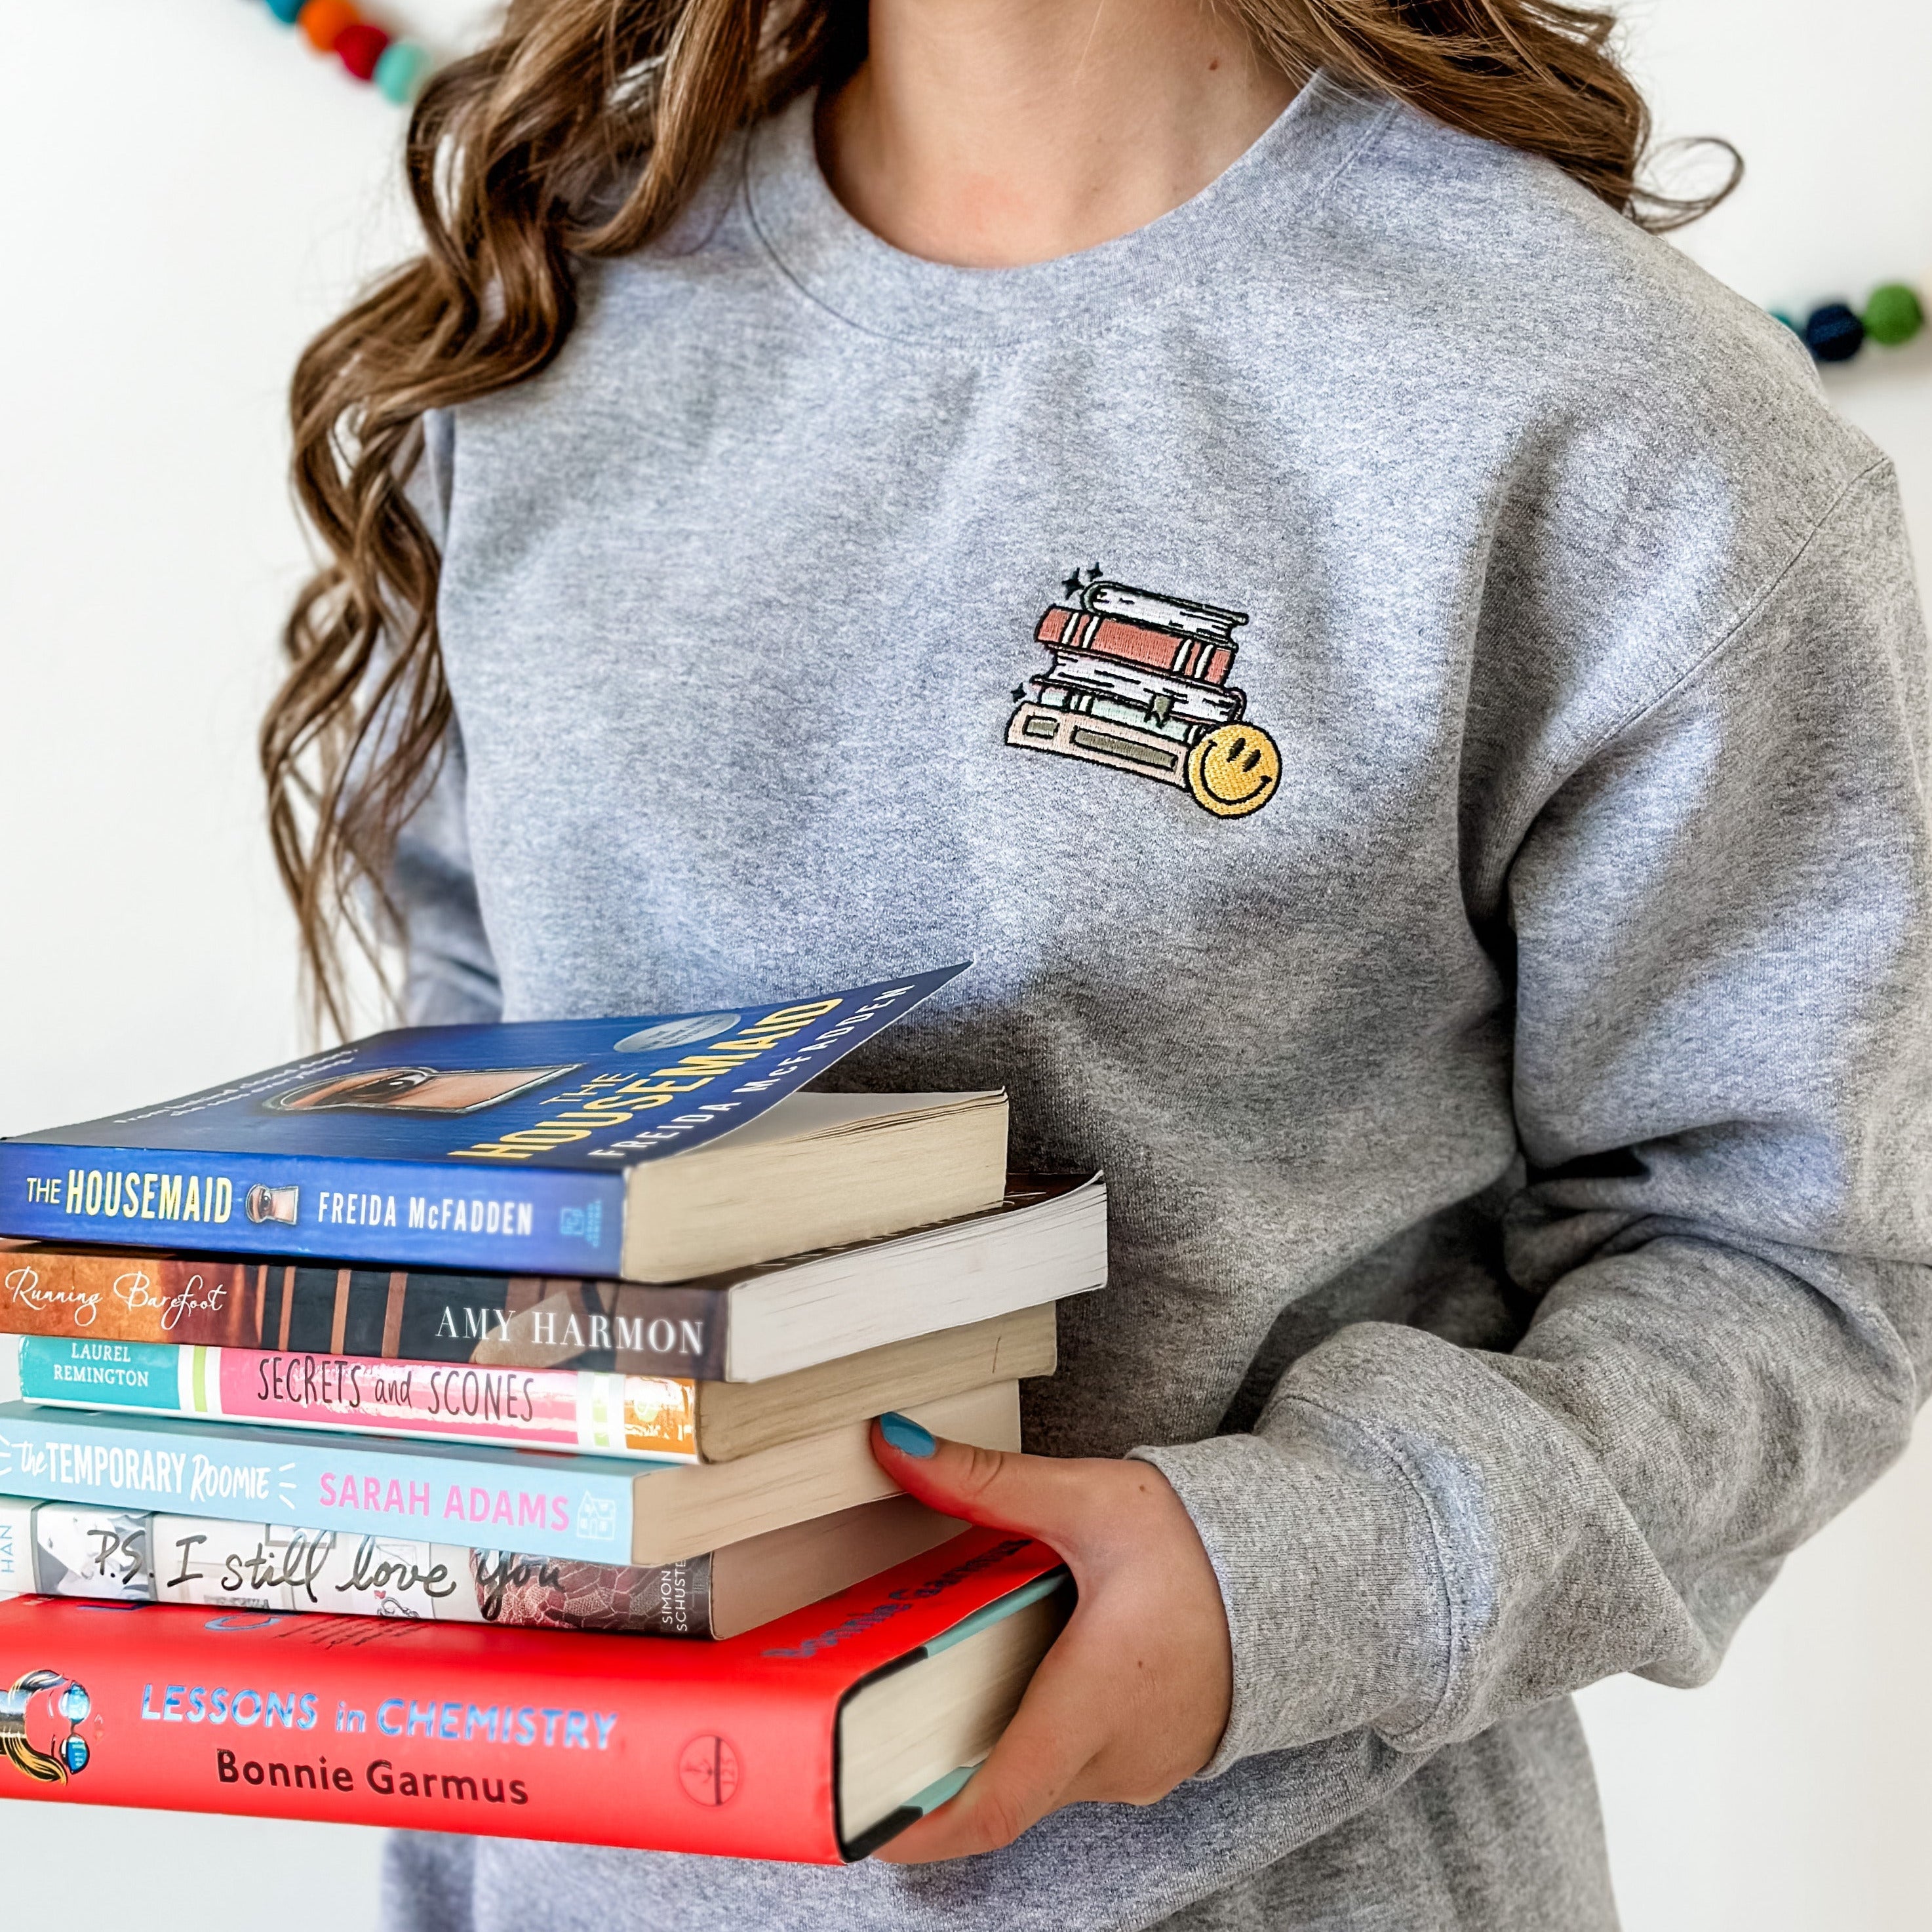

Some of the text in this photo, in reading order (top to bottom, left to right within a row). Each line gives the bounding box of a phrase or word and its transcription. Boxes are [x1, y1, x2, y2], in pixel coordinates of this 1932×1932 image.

[447, 998, 844, 1158] HOUSEMAID
[540, 1072, 639, 1105] THE
[587, 1101, 741, 1158] FREIDA
[732, 984, 917, 1094] McFADDEN
[26, 1169, 233, 1223] THE HOUSEMAID
[319, 1191, 532, 1236] FREIDA McFADDEN
[5, 1266, 227, 1330] Running Barefoot
[71, 1343, 131, 1362] LAUREL
[435, 1306, 703, 1356] AMY HARMON
[54, 1364, 149, 1387] REMINGTON
[258, 1356, 534, 1423] SECRETS and SCONES
[11, 1440, 49, 1476] the
[45, 1443, 186, 1494] TEMPORARY
[320, 1472, 570, 1531] SARAH ADAMS
[0, 1525, 14, 1573] HAN
[167, 1535, 208, 1588] I
[221, 1528, 332, 1603] still
[336, 1535, 457, 1598] love
[470, 1547, 565, 1621] you
[660, 1570, 673, 1625] SIMON
[675, 1560, 688, 1632] SCHUSTE
[141, 1682, 618, 1750] LESSONS in CHEMISTRY
[217, 1748, 530, 1805] Bonnie Garmus
